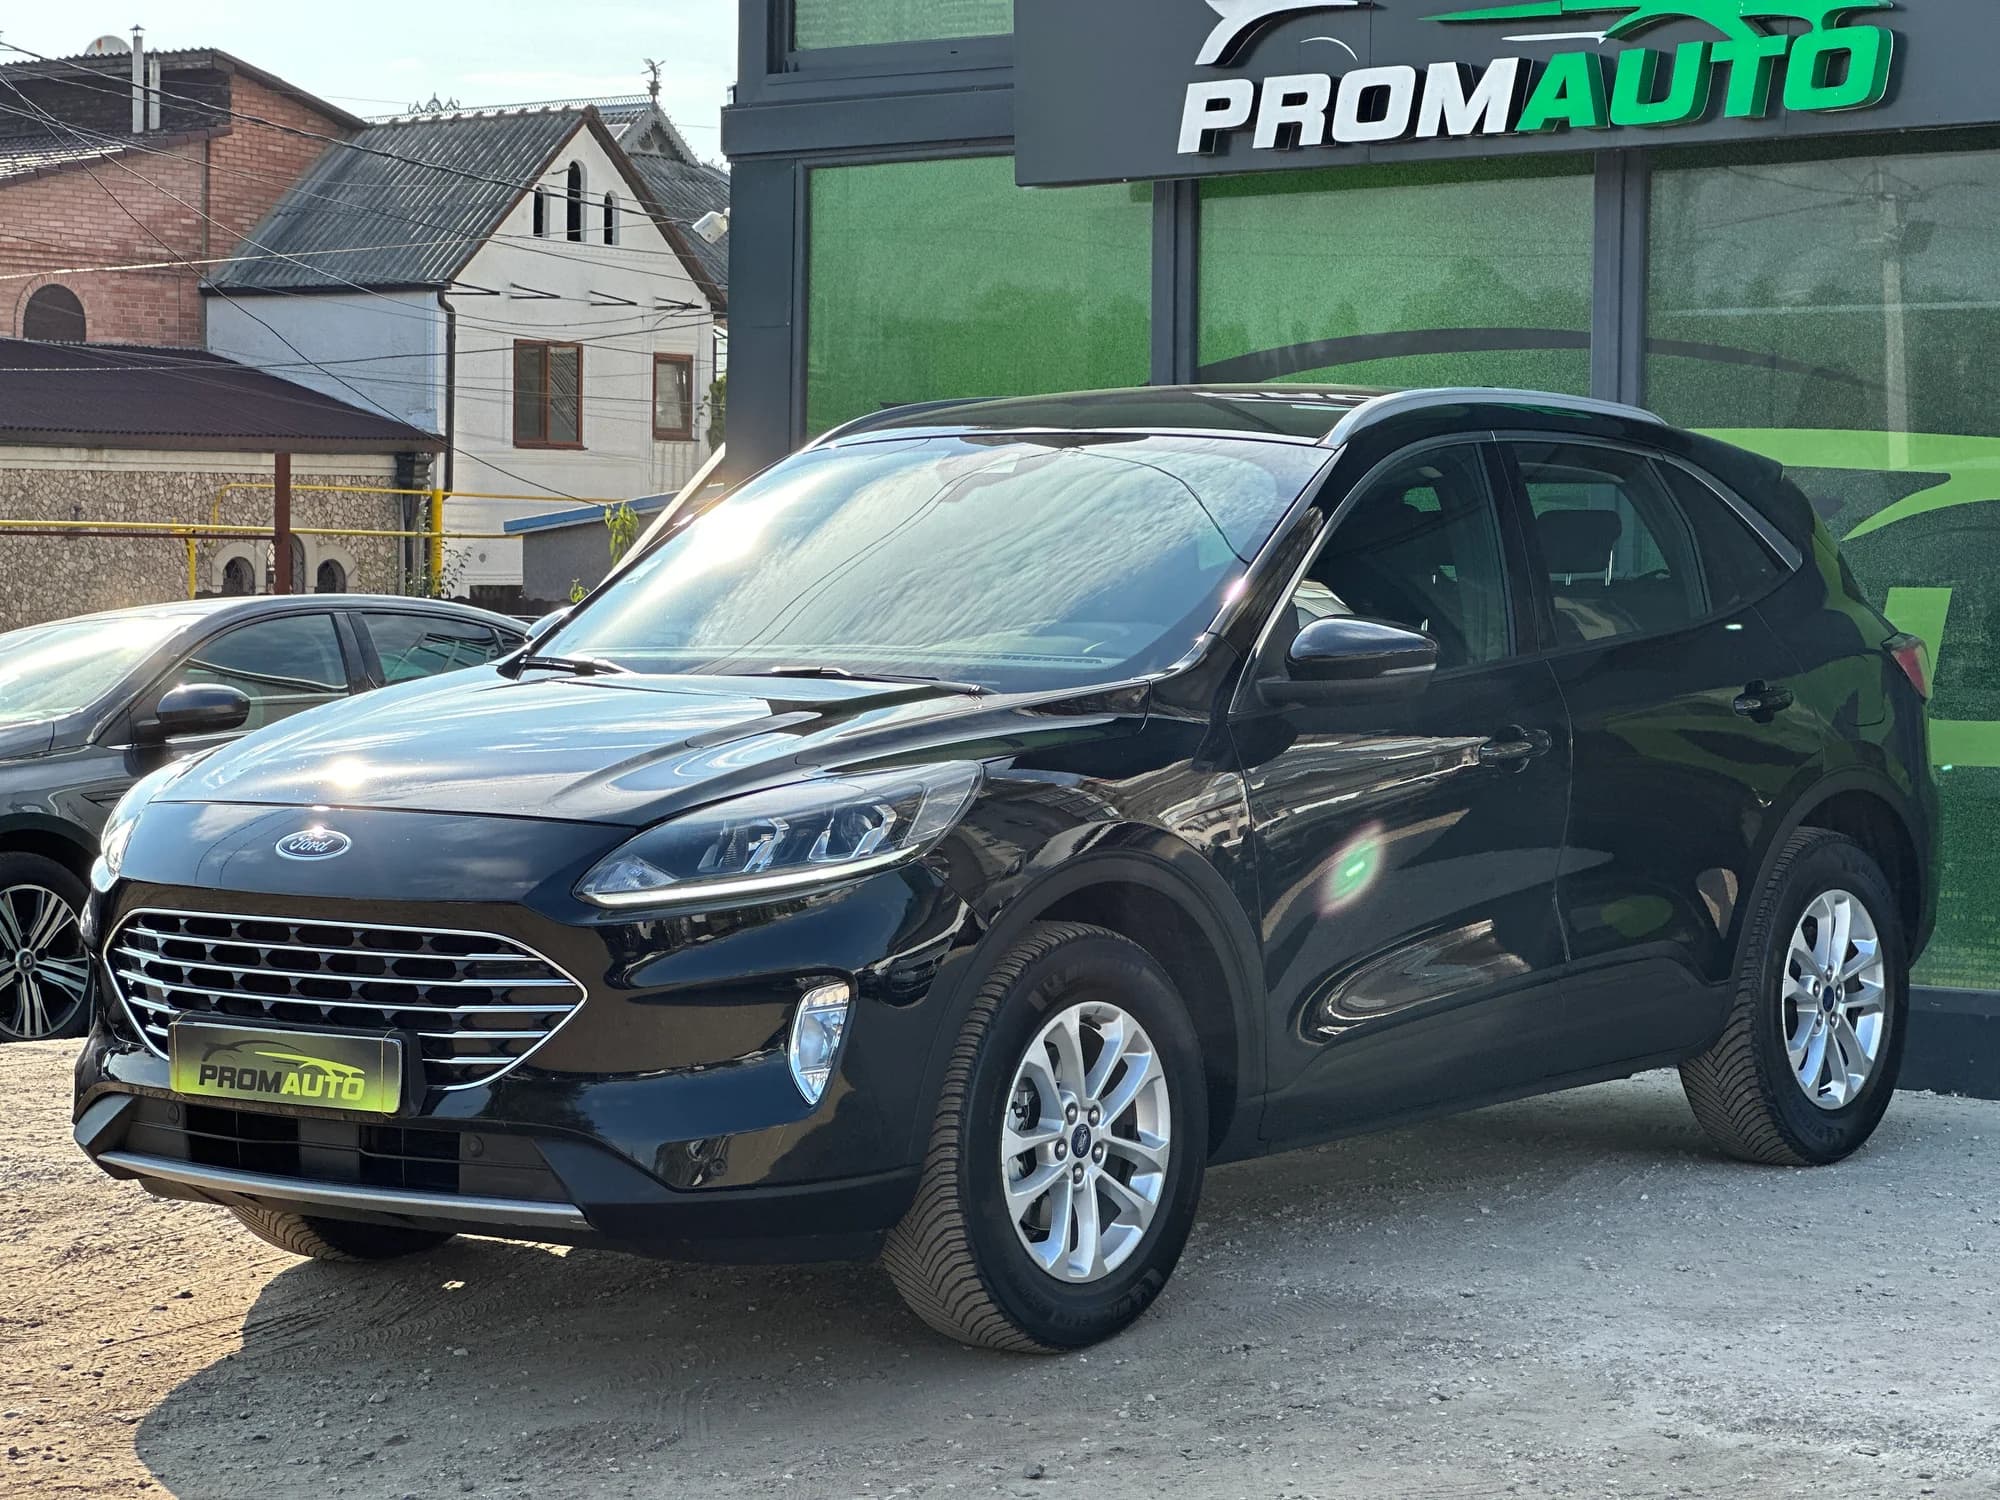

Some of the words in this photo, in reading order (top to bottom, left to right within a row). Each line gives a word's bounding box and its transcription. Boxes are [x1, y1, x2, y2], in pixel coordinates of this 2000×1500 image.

[1177, 25, 1892, 155] PROMAUTO
[287, 835, 335, 852] Ford
[198, 1063, 365, 1101] PROMAUTO
